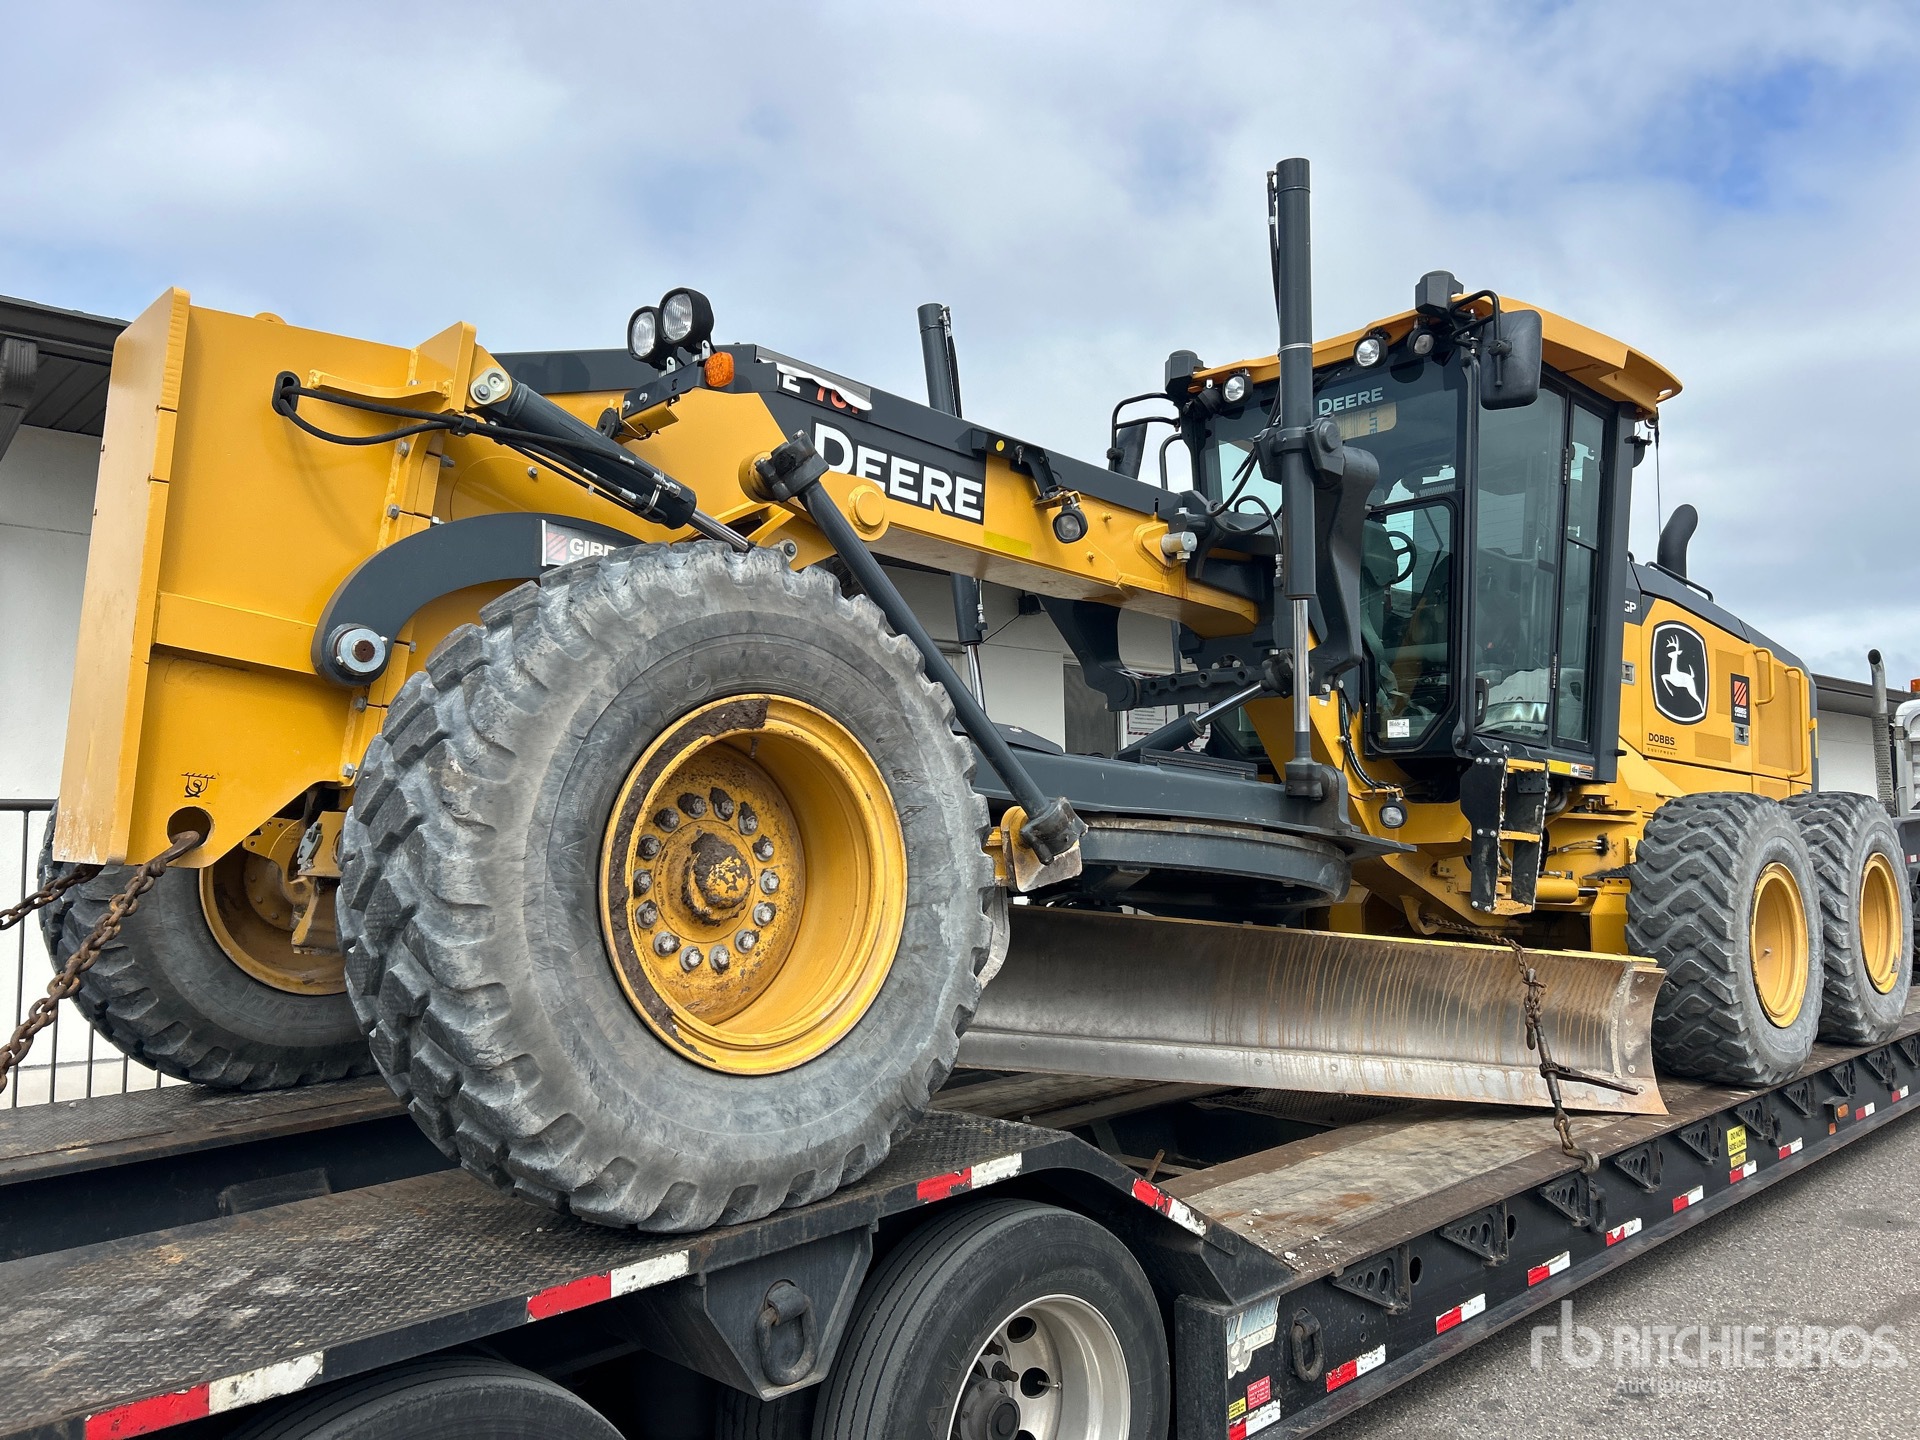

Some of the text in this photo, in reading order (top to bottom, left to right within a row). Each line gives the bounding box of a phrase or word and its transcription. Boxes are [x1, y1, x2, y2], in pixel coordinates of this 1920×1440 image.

[1318, 386, 1384, 416] DEERE
[814, 422, 983, 520] DEERE
[1648, 732, 1675, 746] DOBBS
